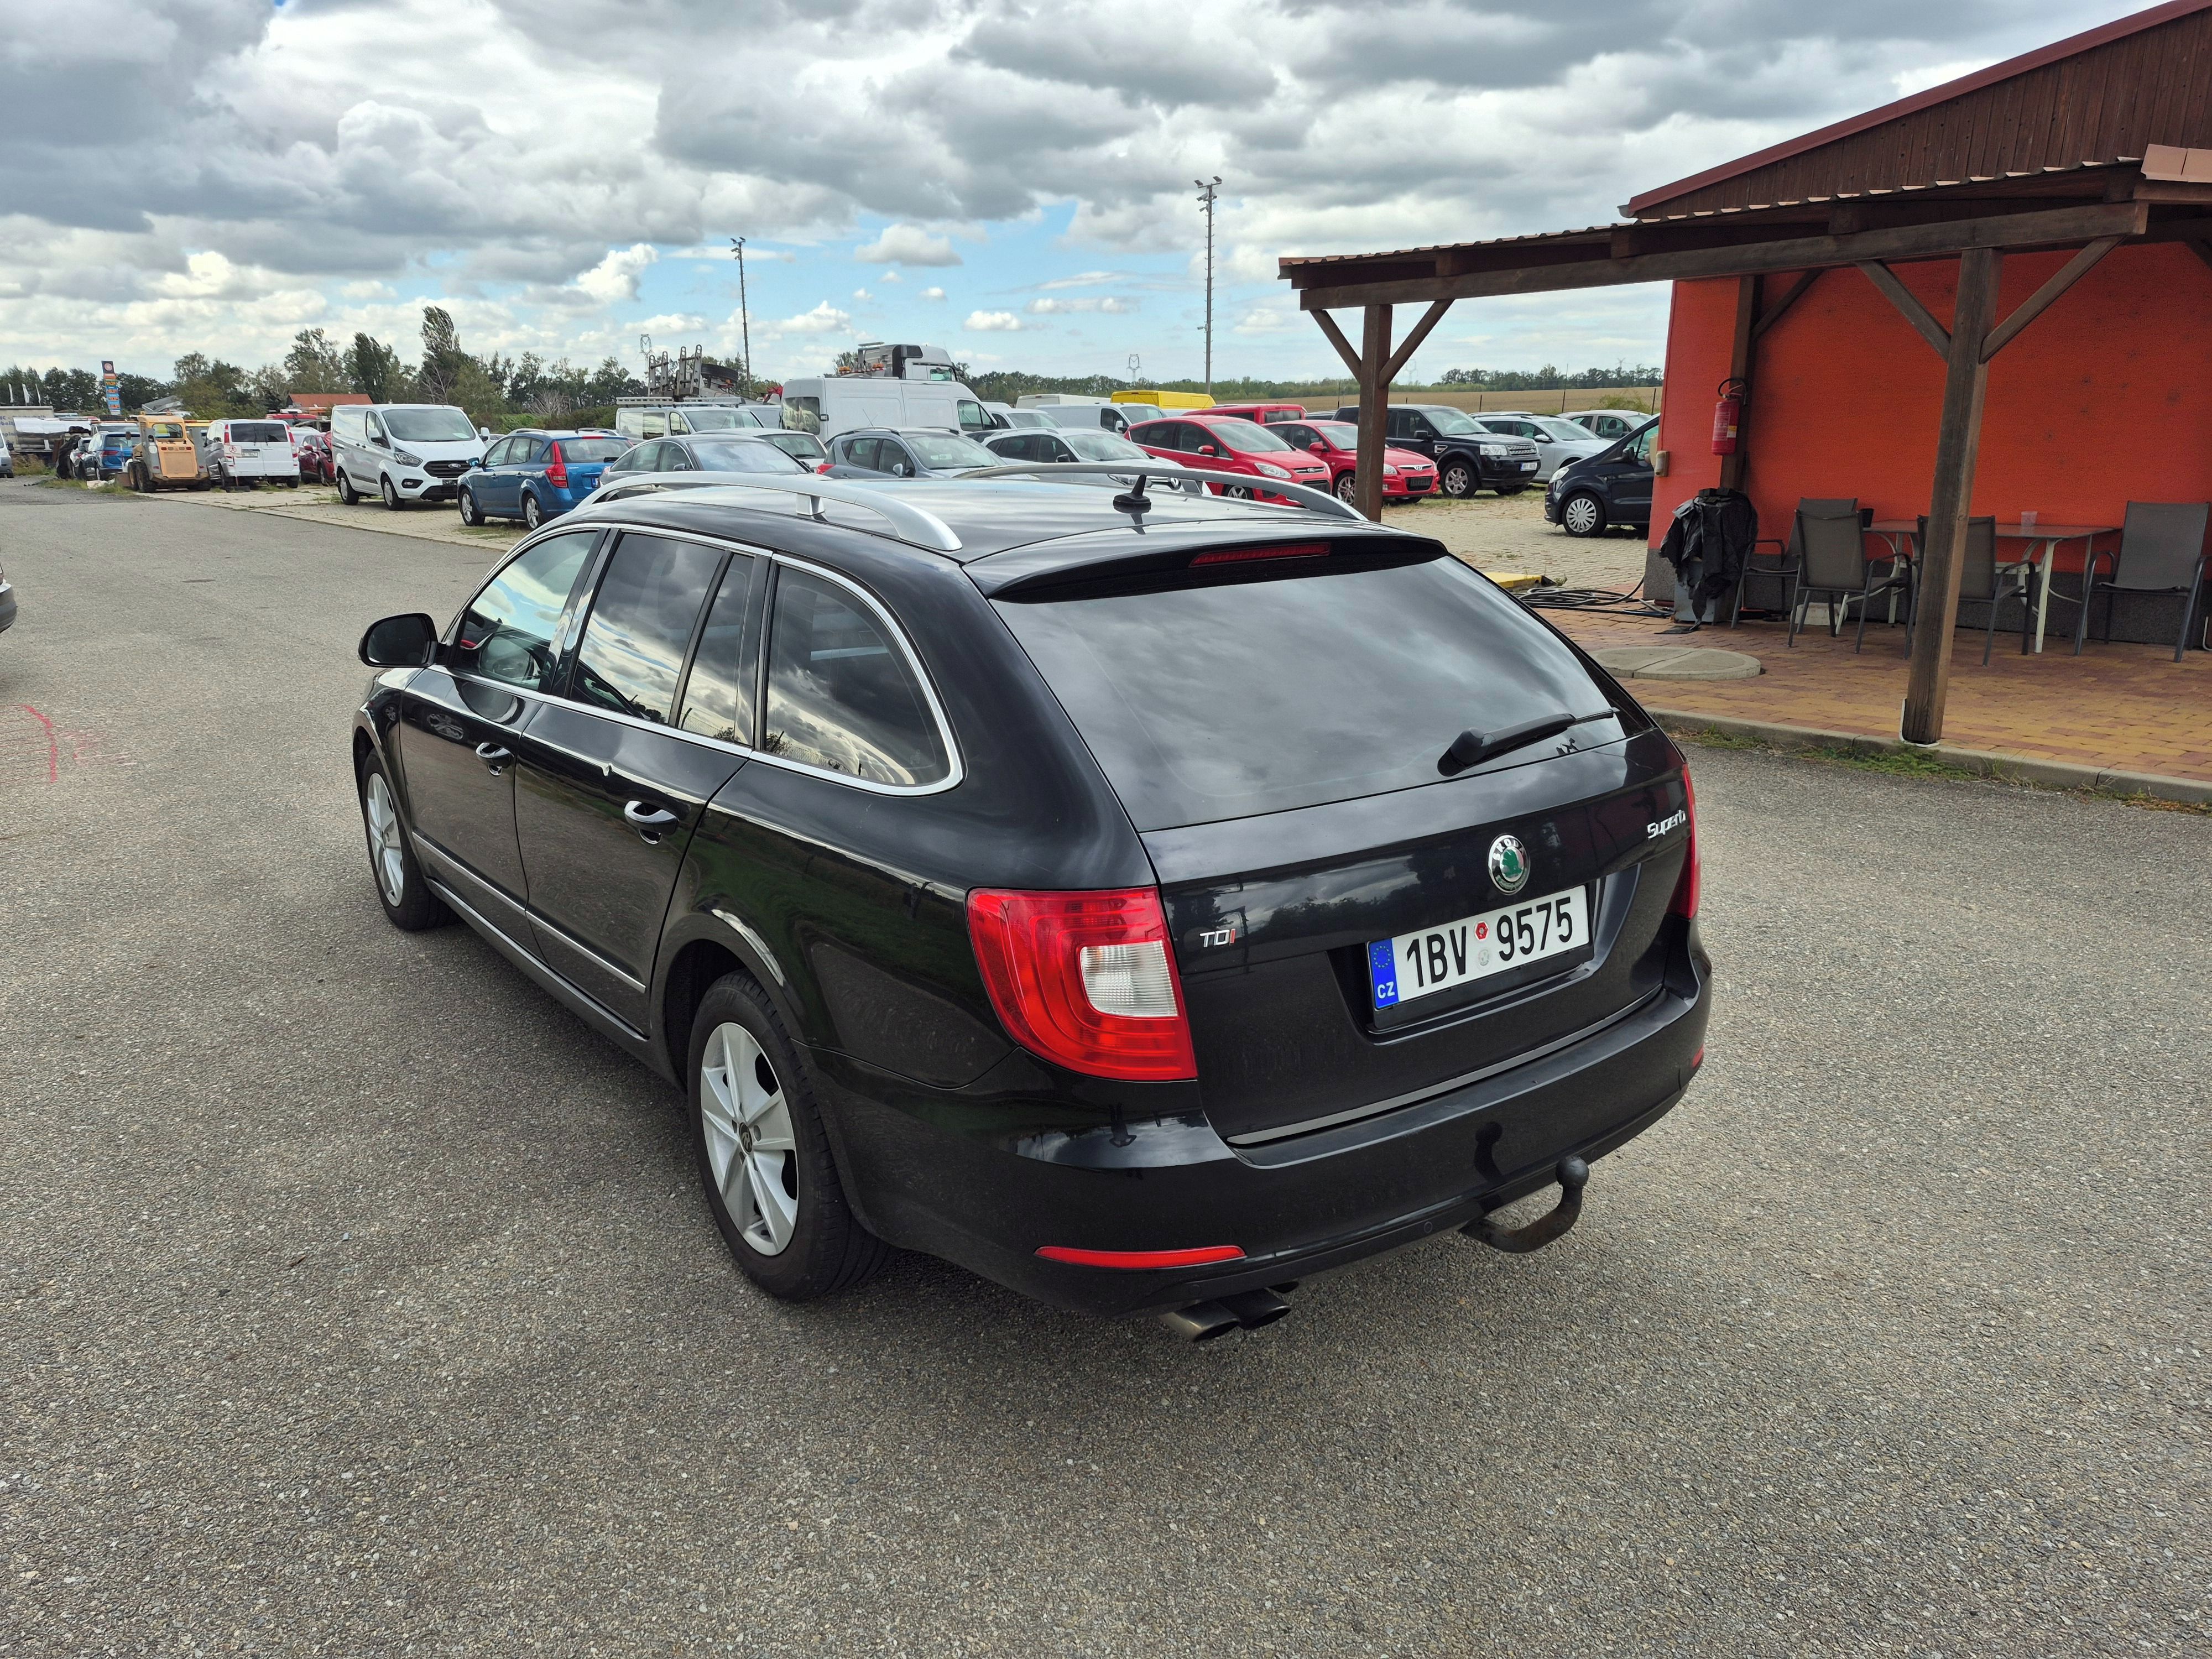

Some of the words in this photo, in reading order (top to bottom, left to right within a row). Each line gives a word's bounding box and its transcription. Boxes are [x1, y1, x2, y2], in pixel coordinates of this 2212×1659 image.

[1647, 809, 1686, 839] Superb
[1199, 928, 1236, 948] TDI
[1406, 925, 1467, 988] 1BV
[1496, 896, 1573, 962] 9575
[1376, 981, 1395, 999] CZ
